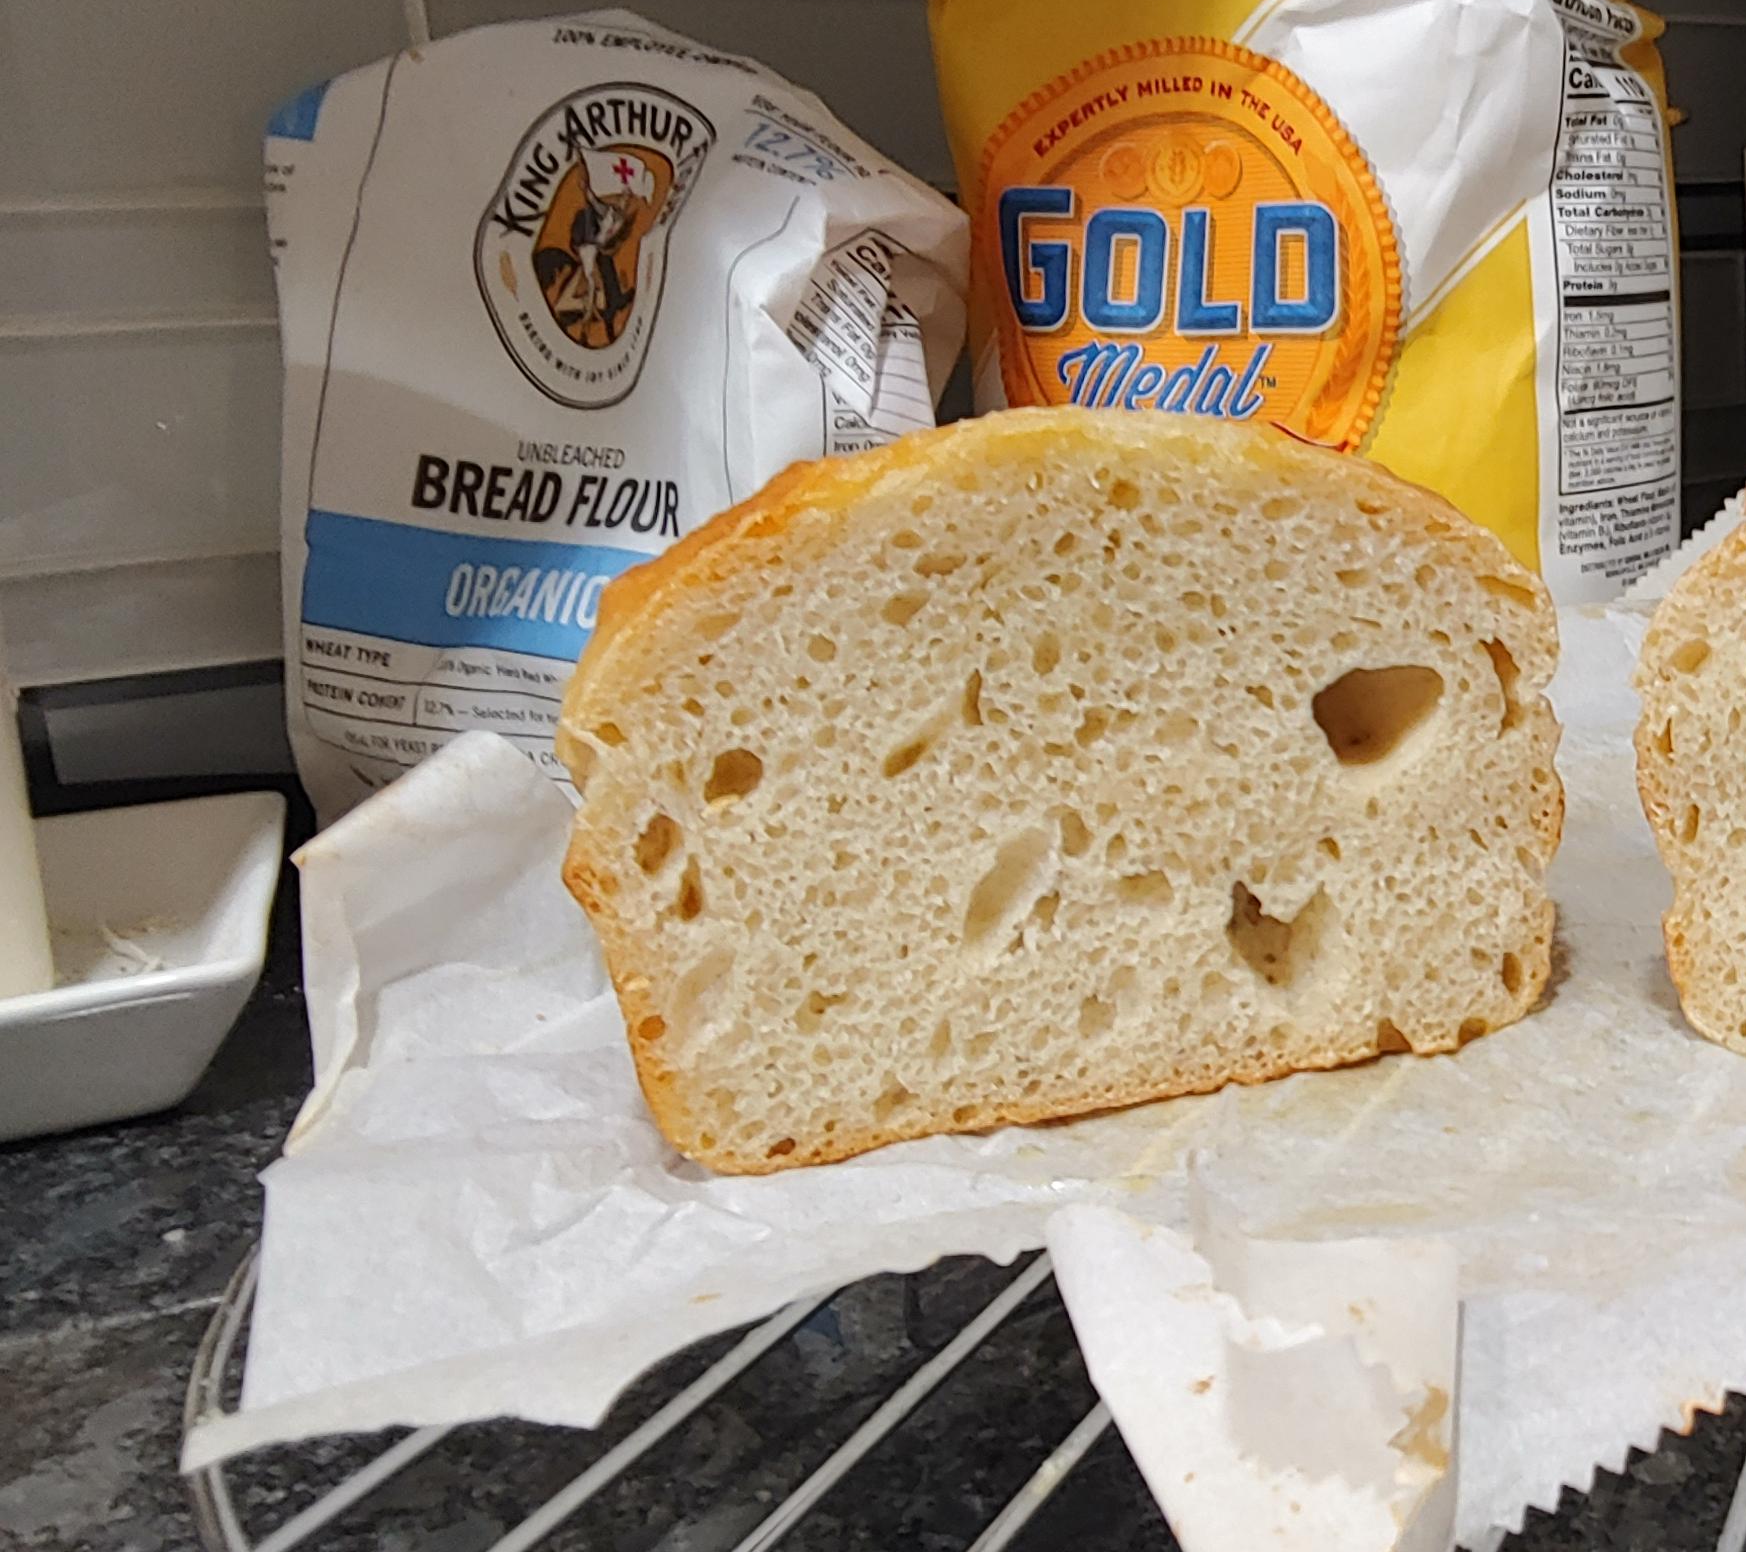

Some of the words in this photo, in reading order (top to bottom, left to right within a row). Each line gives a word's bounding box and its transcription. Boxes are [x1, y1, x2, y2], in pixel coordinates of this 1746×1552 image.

[1032, 85, 1130, 158] EXPERTLY
[1137, 76, 1203, 98] MILLED
[1211, 80, 1233, 100] IN
[1241, 90, 1272, 120] THE
[1271, 114, 1304, 156] USA
[491, 141, 561, 238] KING
[557, 97, 695, 162] ARTHUR
[1556, 188, 1607, 200] Sodium
[1558, 206, 1591, 218] Total
[998, 185, 1340, 334] GOLD
[1562, 280, 1604, 291] Protein
[1057, 340, 1273, 420] Medal
[516, 438, 627, 470] UNBLEACHED
[411, 453, 563, 525] BREAD
[565, 474, 680, 538] FLOUR
[444, 562, 611, 630] ORGANIC
[305, 638, 351, 660] WHEAT
[356, 647, 392, 668] TYPE
